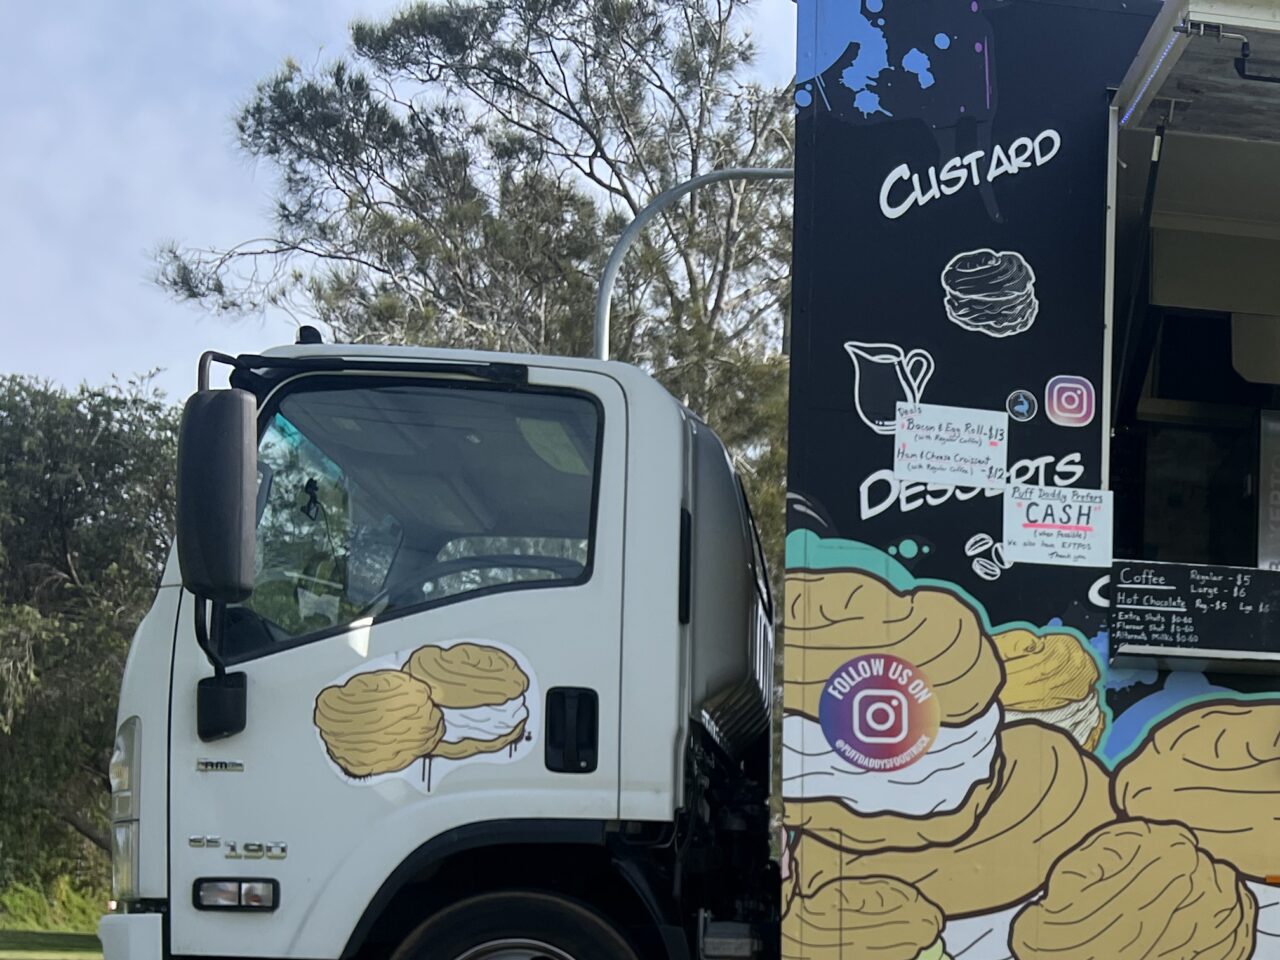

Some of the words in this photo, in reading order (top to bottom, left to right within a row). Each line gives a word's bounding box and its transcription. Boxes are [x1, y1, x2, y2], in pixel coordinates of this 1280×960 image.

[879, 129, 1061, 219] CUSTARD
[907, 417, 935, 431] Bacon
[945, 422, 960, 439] Egg
[964, 423, 983, 435] Roll
[896, 447, 917, 459] Ham
[925, 450, 951, 461] Cheese
[953, 453, 991, 465] Croissant
[1011, 486, 1034, 499] Puff
[1038, 488, 1067, 504] Daddy
[1071, 490, 1103, 501] Prefers
[1119, 567, 1166, 585] Coffee
[1116, 592, 1139, 605] Hot
[1142, 595, 1186, 608] Chocolate
[1190, 584, 1219, 599] Large
[1117, 611, 1141, 621] Extra
[827, 658, 885, 701] FOLLOW
[888, 661, 913, 686] US
[908, 679, 933, 705] ON
[224, 841, 288, 860] 190
